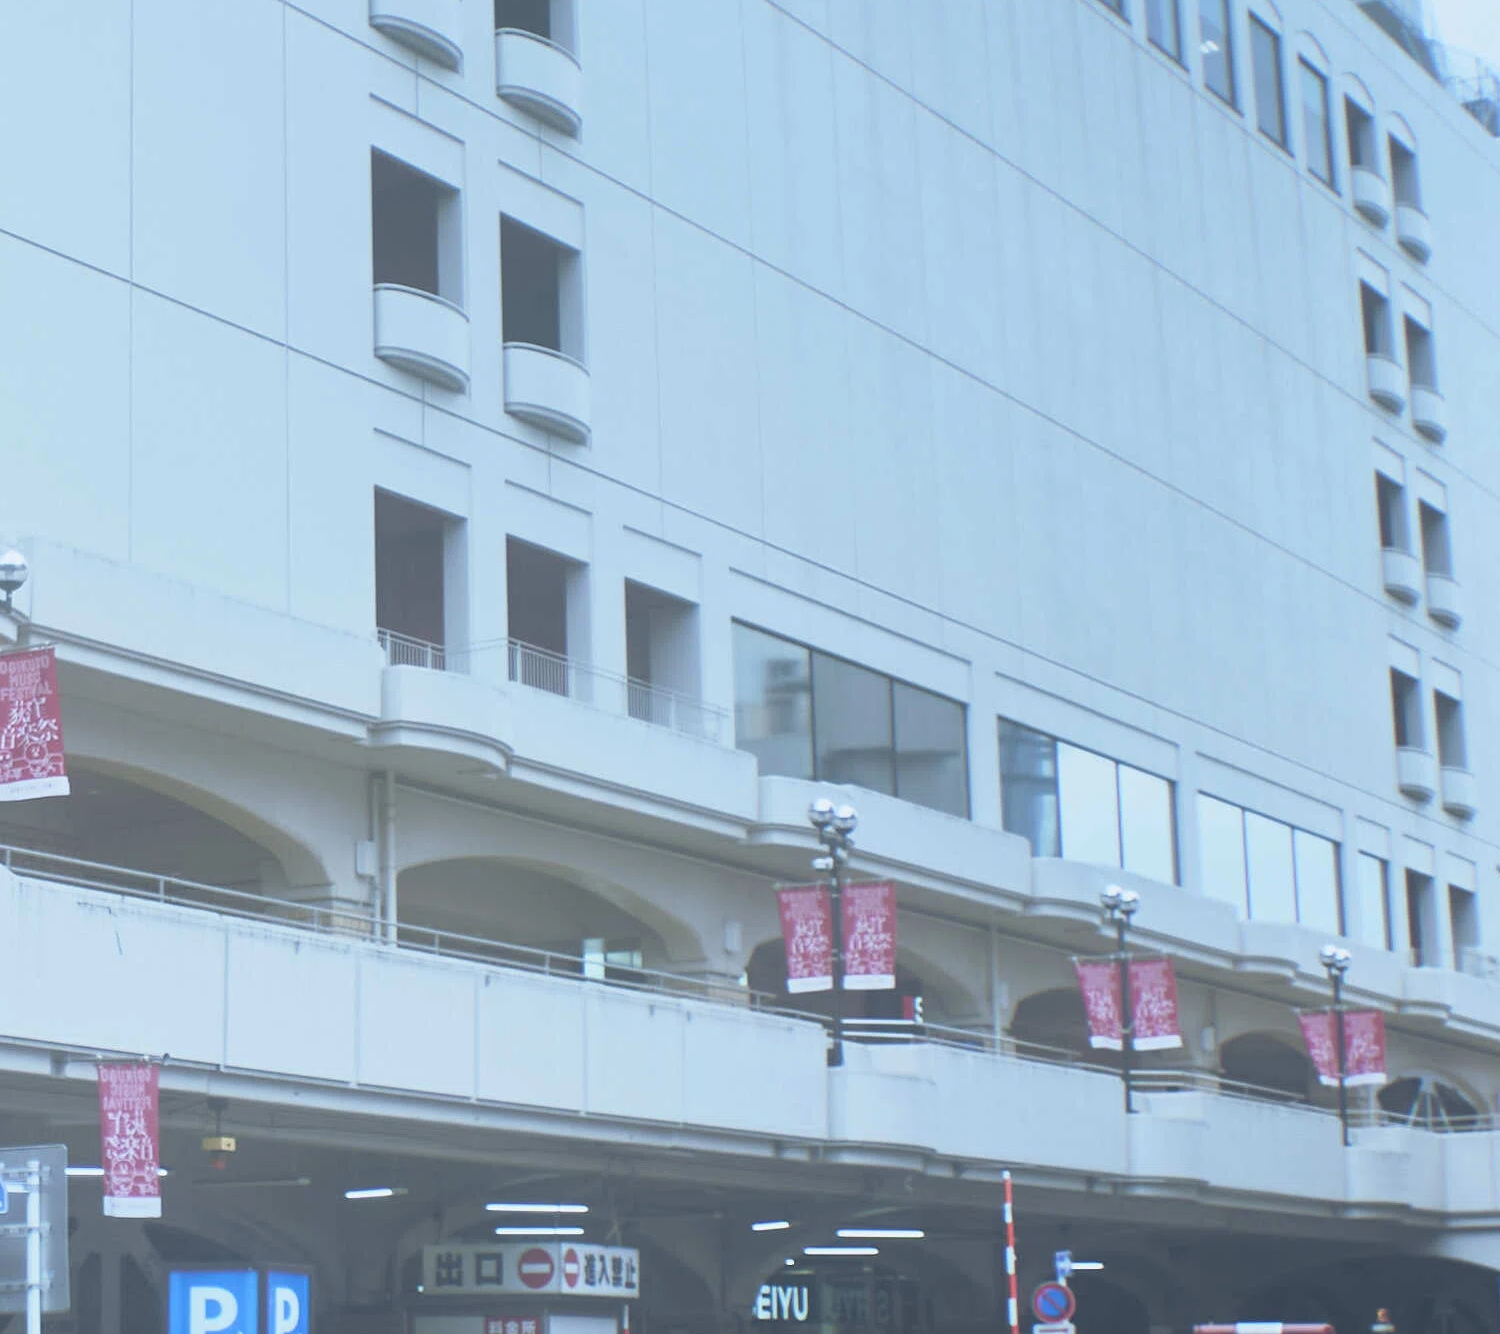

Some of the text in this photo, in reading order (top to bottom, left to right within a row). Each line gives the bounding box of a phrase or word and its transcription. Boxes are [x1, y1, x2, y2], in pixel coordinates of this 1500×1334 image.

[436, 1252, 503, 1287] 出口
[584, 1254, 636, 1289] 進入禁止
[752, 1284, 808, 1321] EIYU
